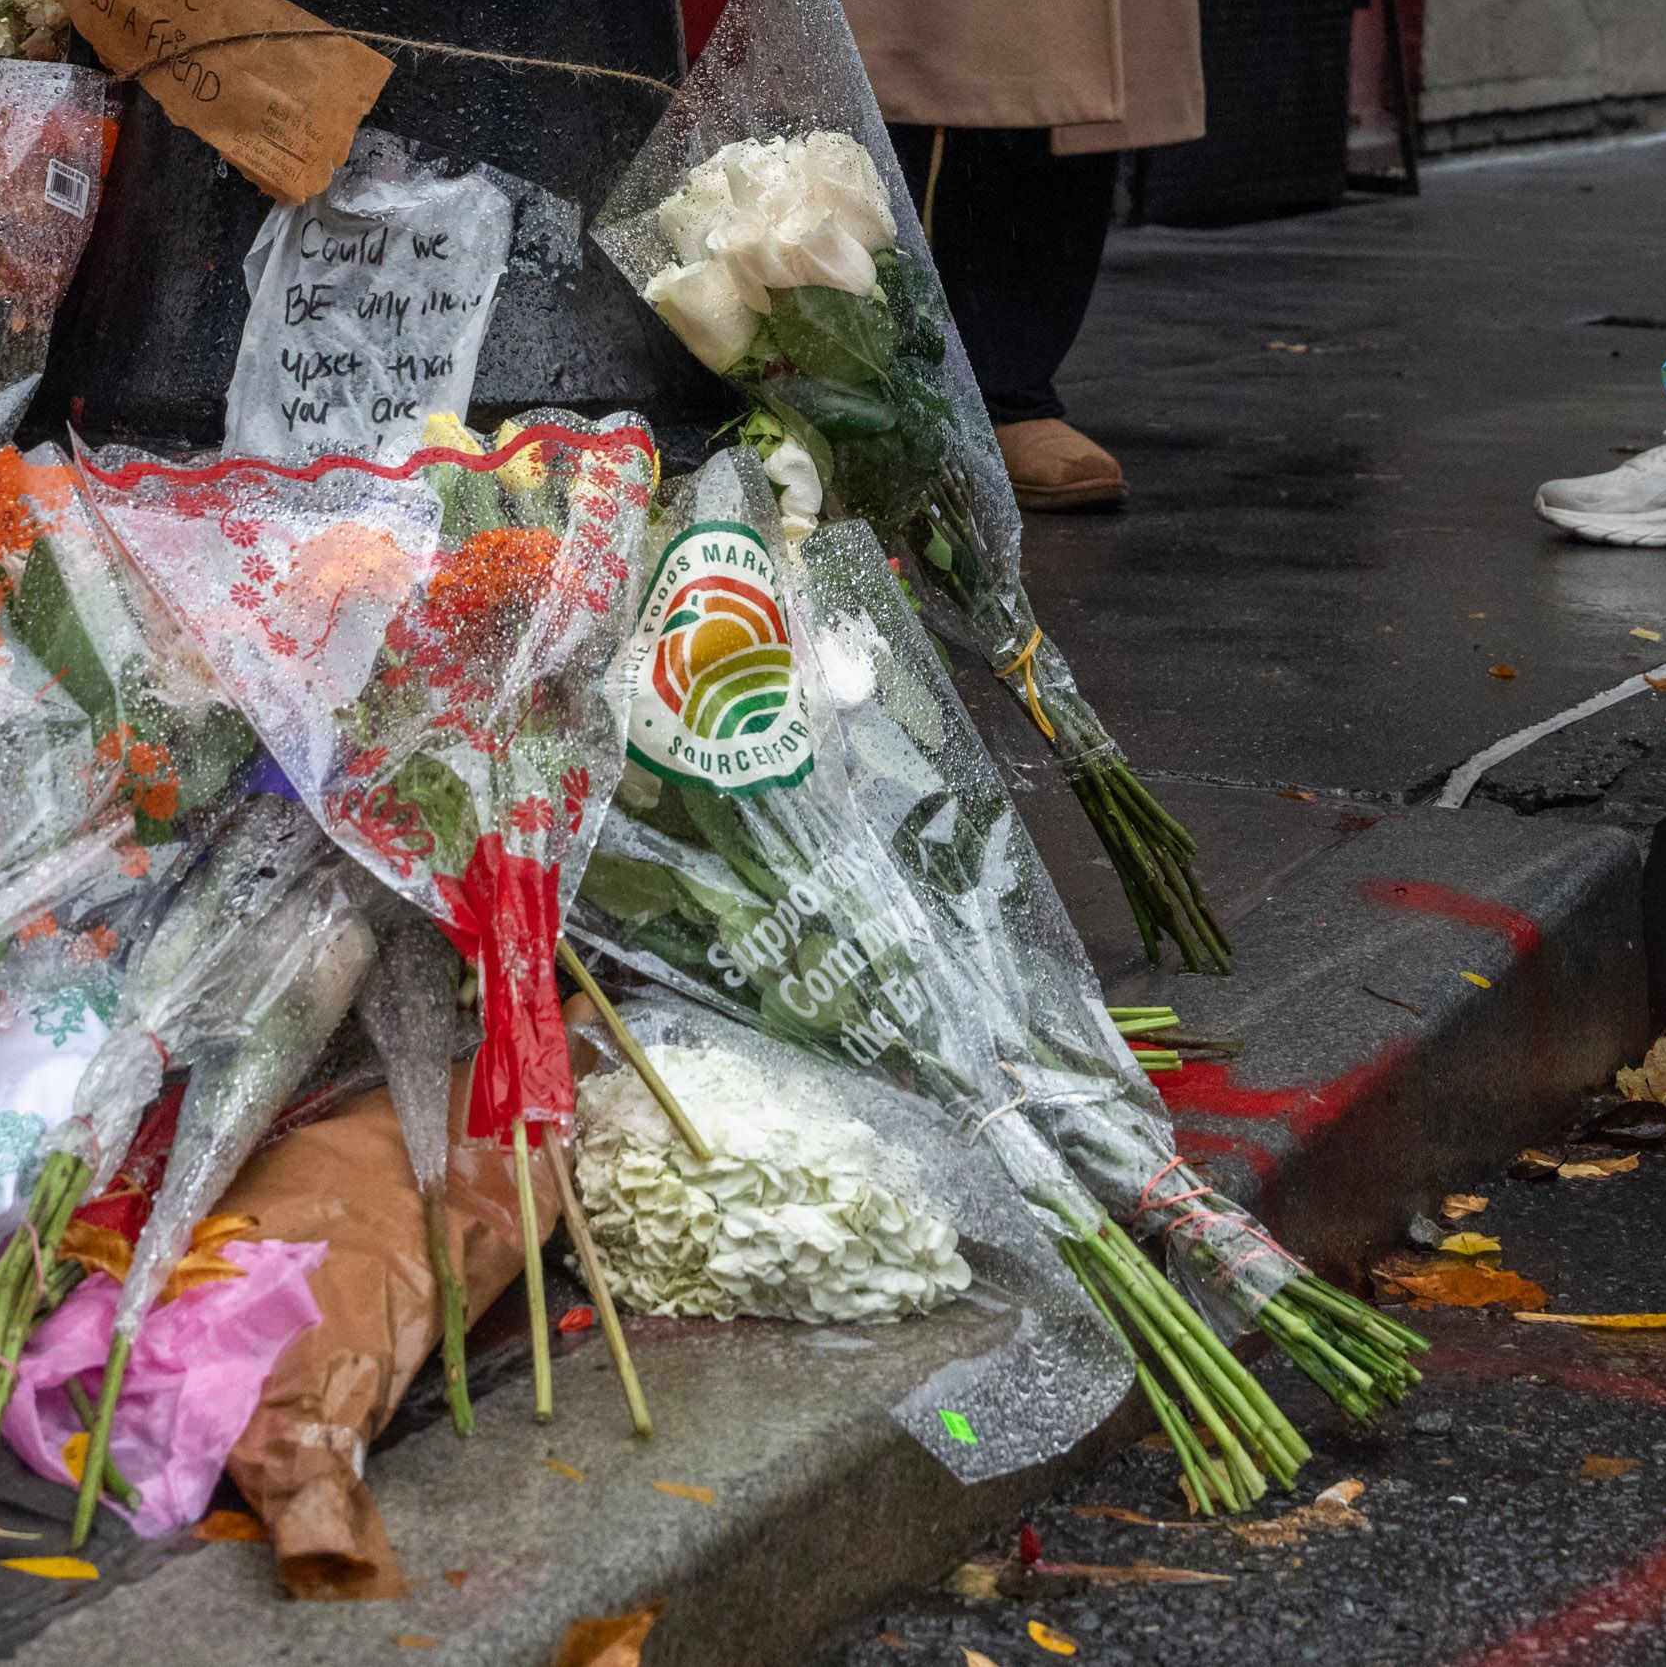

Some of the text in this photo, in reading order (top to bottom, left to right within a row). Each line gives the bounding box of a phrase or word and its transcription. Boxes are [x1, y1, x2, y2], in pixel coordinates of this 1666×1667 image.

[123, 6, 138, 36] A
[301, 217, 450, 266] Could we
[284, 283, 334, 327] BE
[357, 290, 411, 337] any
[281, 348, 363, 392] upset
[281, 396, 420, 433] you are
[643, 554, 692, 633] FOODS
[701, 542, 781, 602] MARKE
